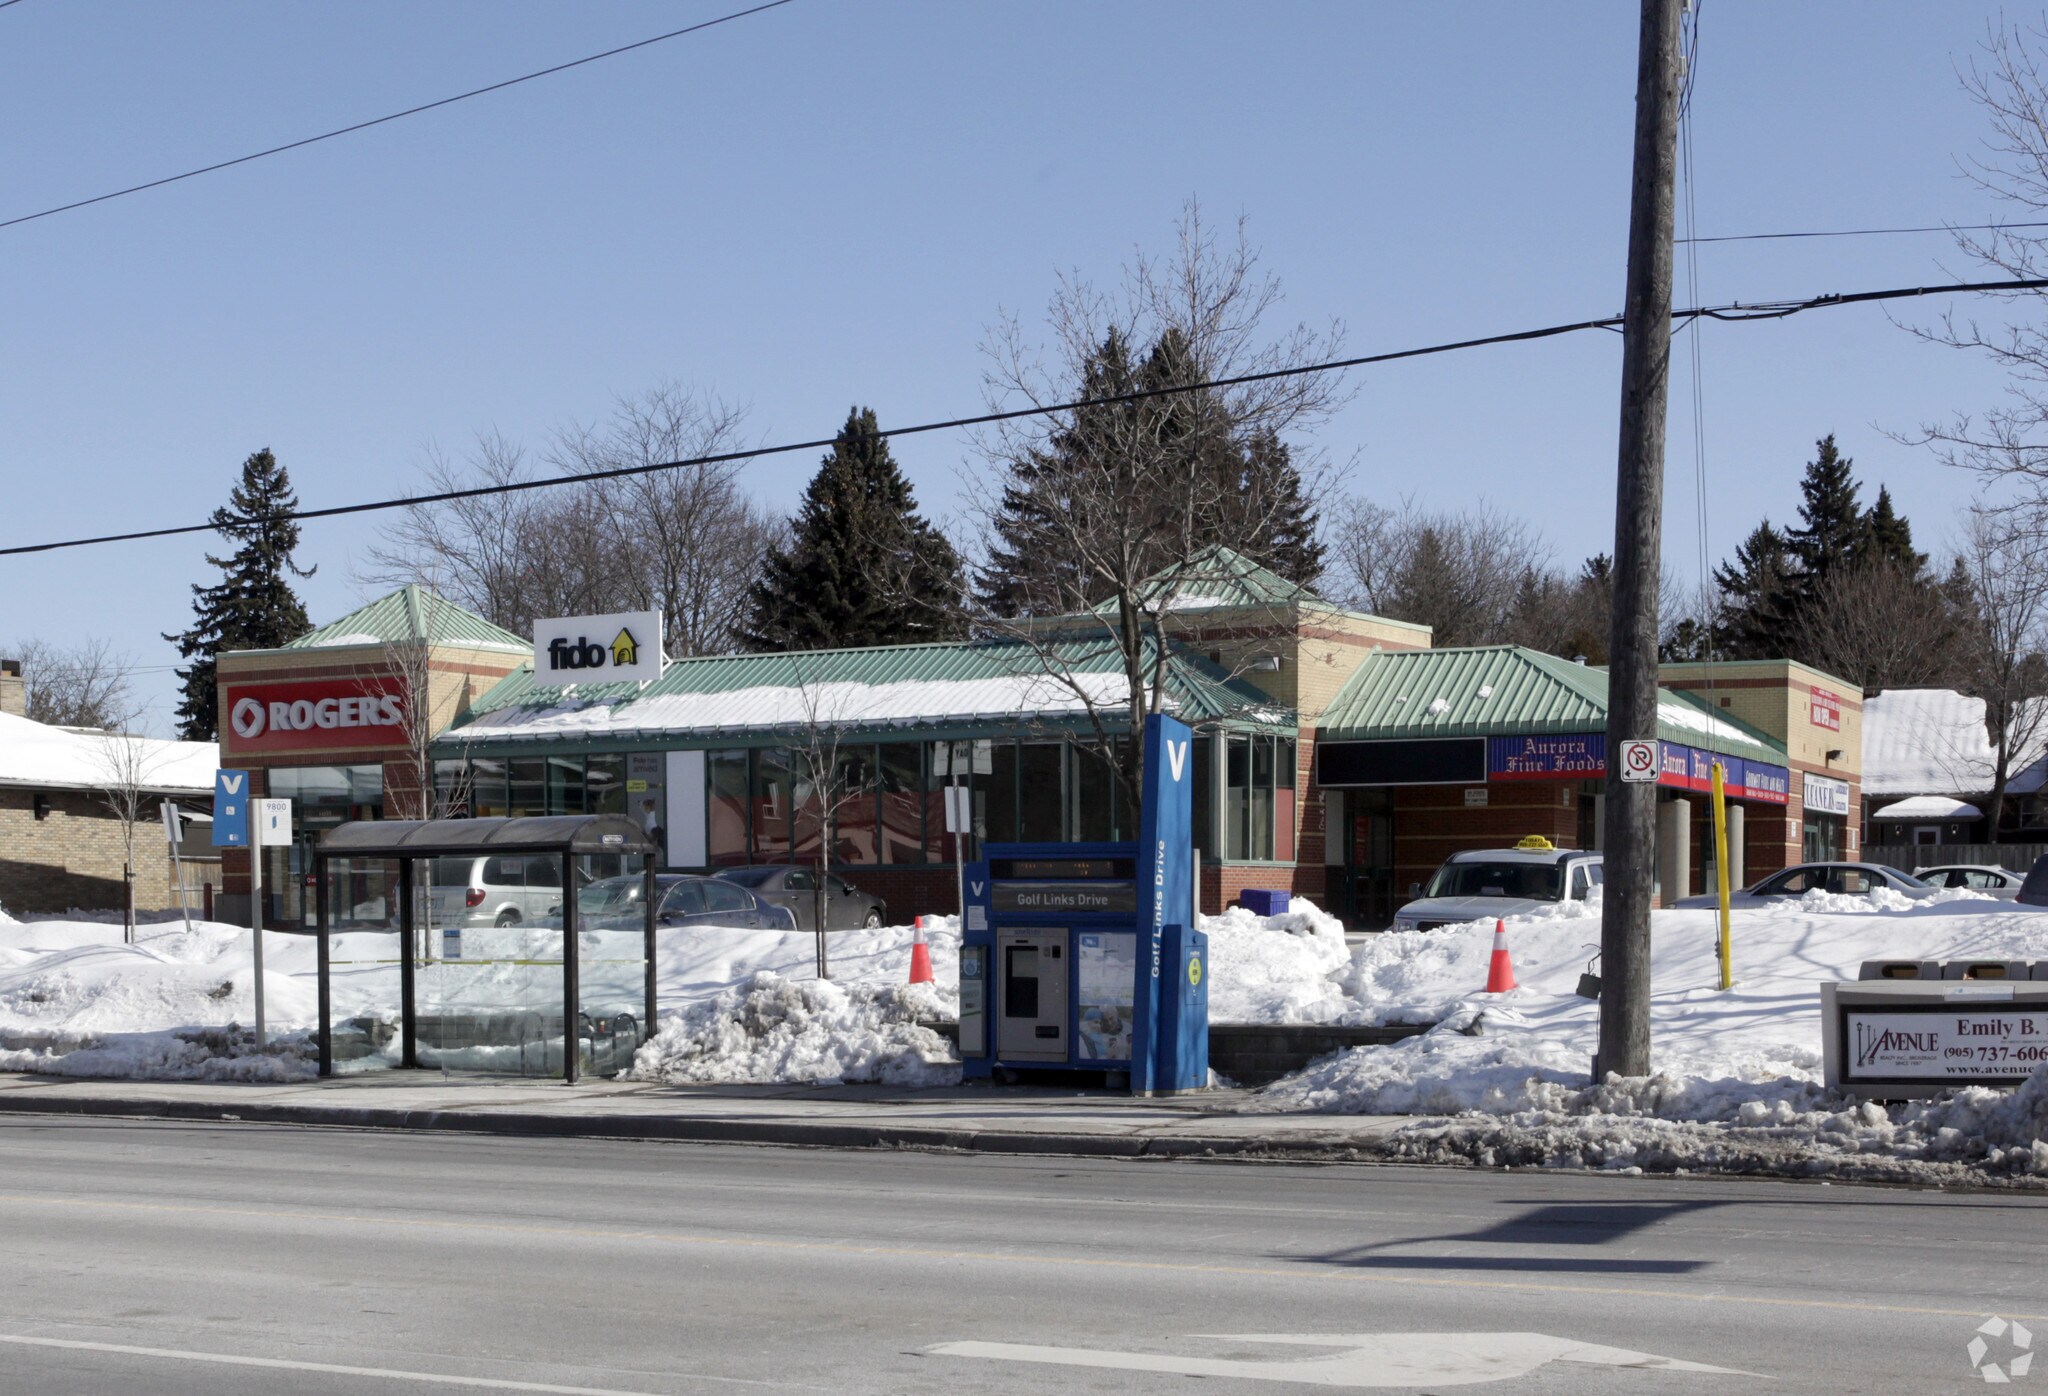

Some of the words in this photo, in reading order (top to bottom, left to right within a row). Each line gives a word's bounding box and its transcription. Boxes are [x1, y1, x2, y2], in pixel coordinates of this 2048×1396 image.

[548, 637, 606, 670] fido
[269, 695, 403, 731] ROGERS
[1524, 739, 1585, 754] Aurora
[1662, 745, 1686, 775] Aurora
[1505, 757, 1544, 772] Fine
[1552, 755, 1605, 771] Foods
[1694, 752, 1708, 780] Fine
[221, 775, 242, 794] V
[266, 803, 287, 811] 9800
[1155, 840, 1165, 886] Drive
[1017, 893, 1041, 905] Golf
[1044, 893, 1075, 905] Links
[1078, 893, 1108, 905] Drive
[1153, 890, 1163, 938] Links
[1152, 942, 1161, 978] Golf
[1957, 1019, 2014, 1039] Emily
[2020, 1018, 2040, 1035] B.
[1868, 1028, 1939, 1058] AVENUE
[1944, 1047, 1974, 1059] (905)
